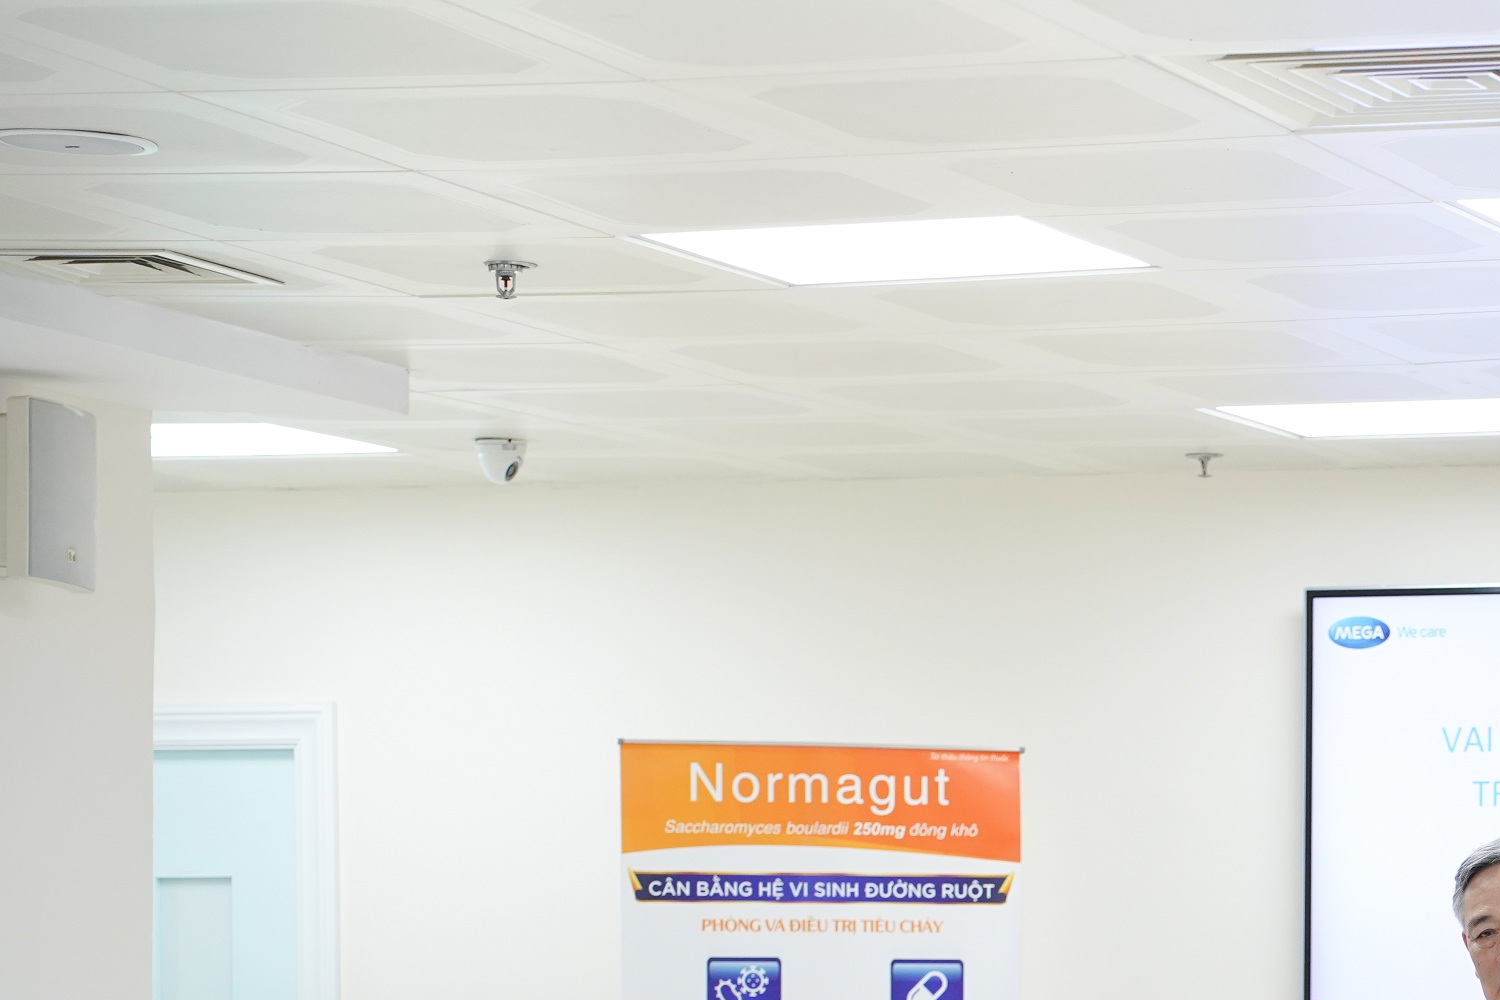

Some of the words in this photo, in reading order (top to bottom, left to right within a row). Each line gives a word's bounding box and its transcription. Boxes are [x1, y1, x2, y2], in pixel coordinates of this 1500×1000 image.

[1334, 625, 1385, 641] MEGA
[1397, 626, 1417, 638] We
[1419, 627, 1446, 638] care
[1442, 726, 1493, 753] VAI
[690, 761, 950, 816] Normagut
[664, 819, 782, 838] Saccharomyces
[786, 821, 849, 836] boulardii
[853, 822, 906, 840] 250mg
[909, 823, 948, 840] đông
[950, 823, 979, 837] khô
[648, 877, 691, 897] CÂN
[696, 875, 753, 897] BẰNG
[758, 878, 784, 901] HỆ
[789, 882, 808, 897] VI
[814, 882, 859, 898] SINH
[864, 879, 936, 899] ĐƯỜNG
[941, 880, 995, 902] RUỘT
